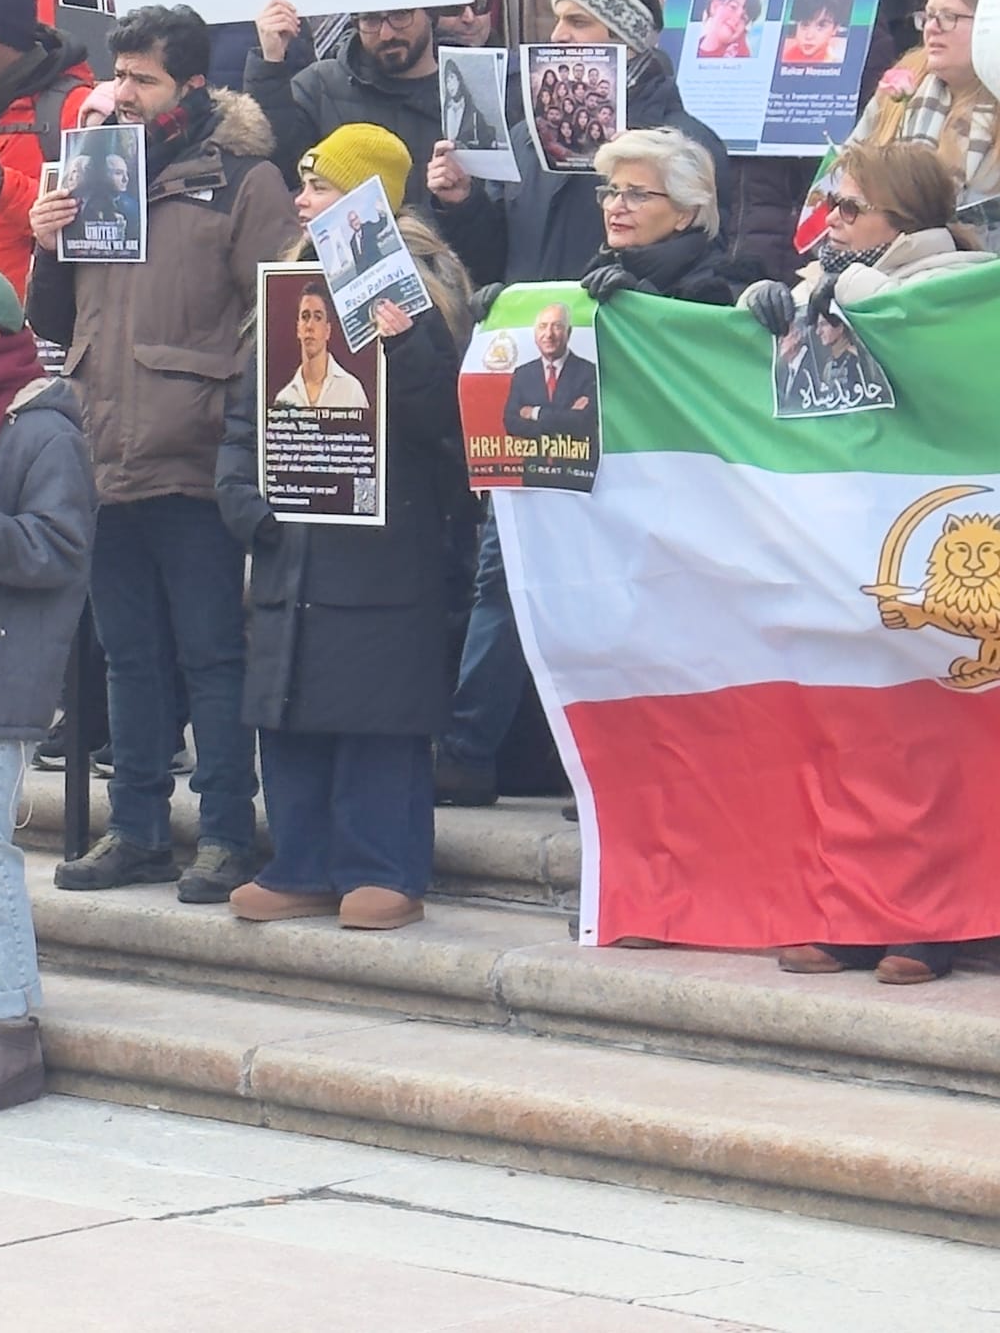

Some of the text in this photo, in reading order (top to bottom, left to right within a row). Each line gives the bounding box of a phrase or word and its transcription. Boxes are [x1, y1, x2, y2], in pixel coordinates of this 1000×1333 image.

[470, 434, 590, 460] HRH Reza Pahlavi
[470, 465, 494, 473] AKE
